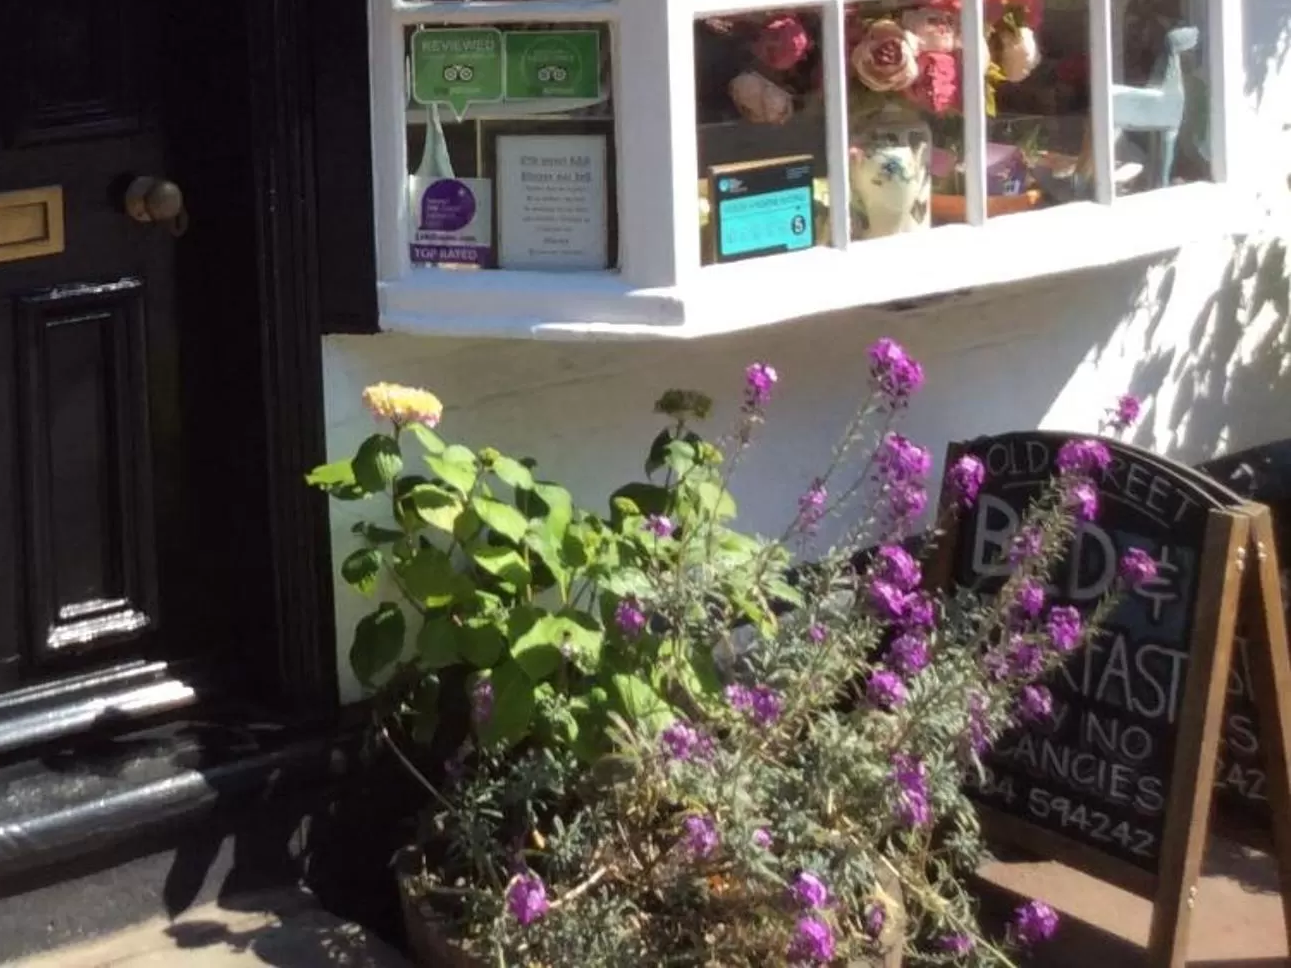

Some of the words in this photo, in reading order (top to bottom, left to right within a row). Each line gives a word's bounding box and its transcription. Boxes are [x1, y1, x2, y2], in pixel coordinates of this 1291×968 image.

[986, 440, 1049, 476] OLD
[1101, 456, 1202, 523] REET
[972, 493, 1117, 600] BD
[1085, 711, 1153, 760] NO
[1027, 787, 1155, 857] 594242
